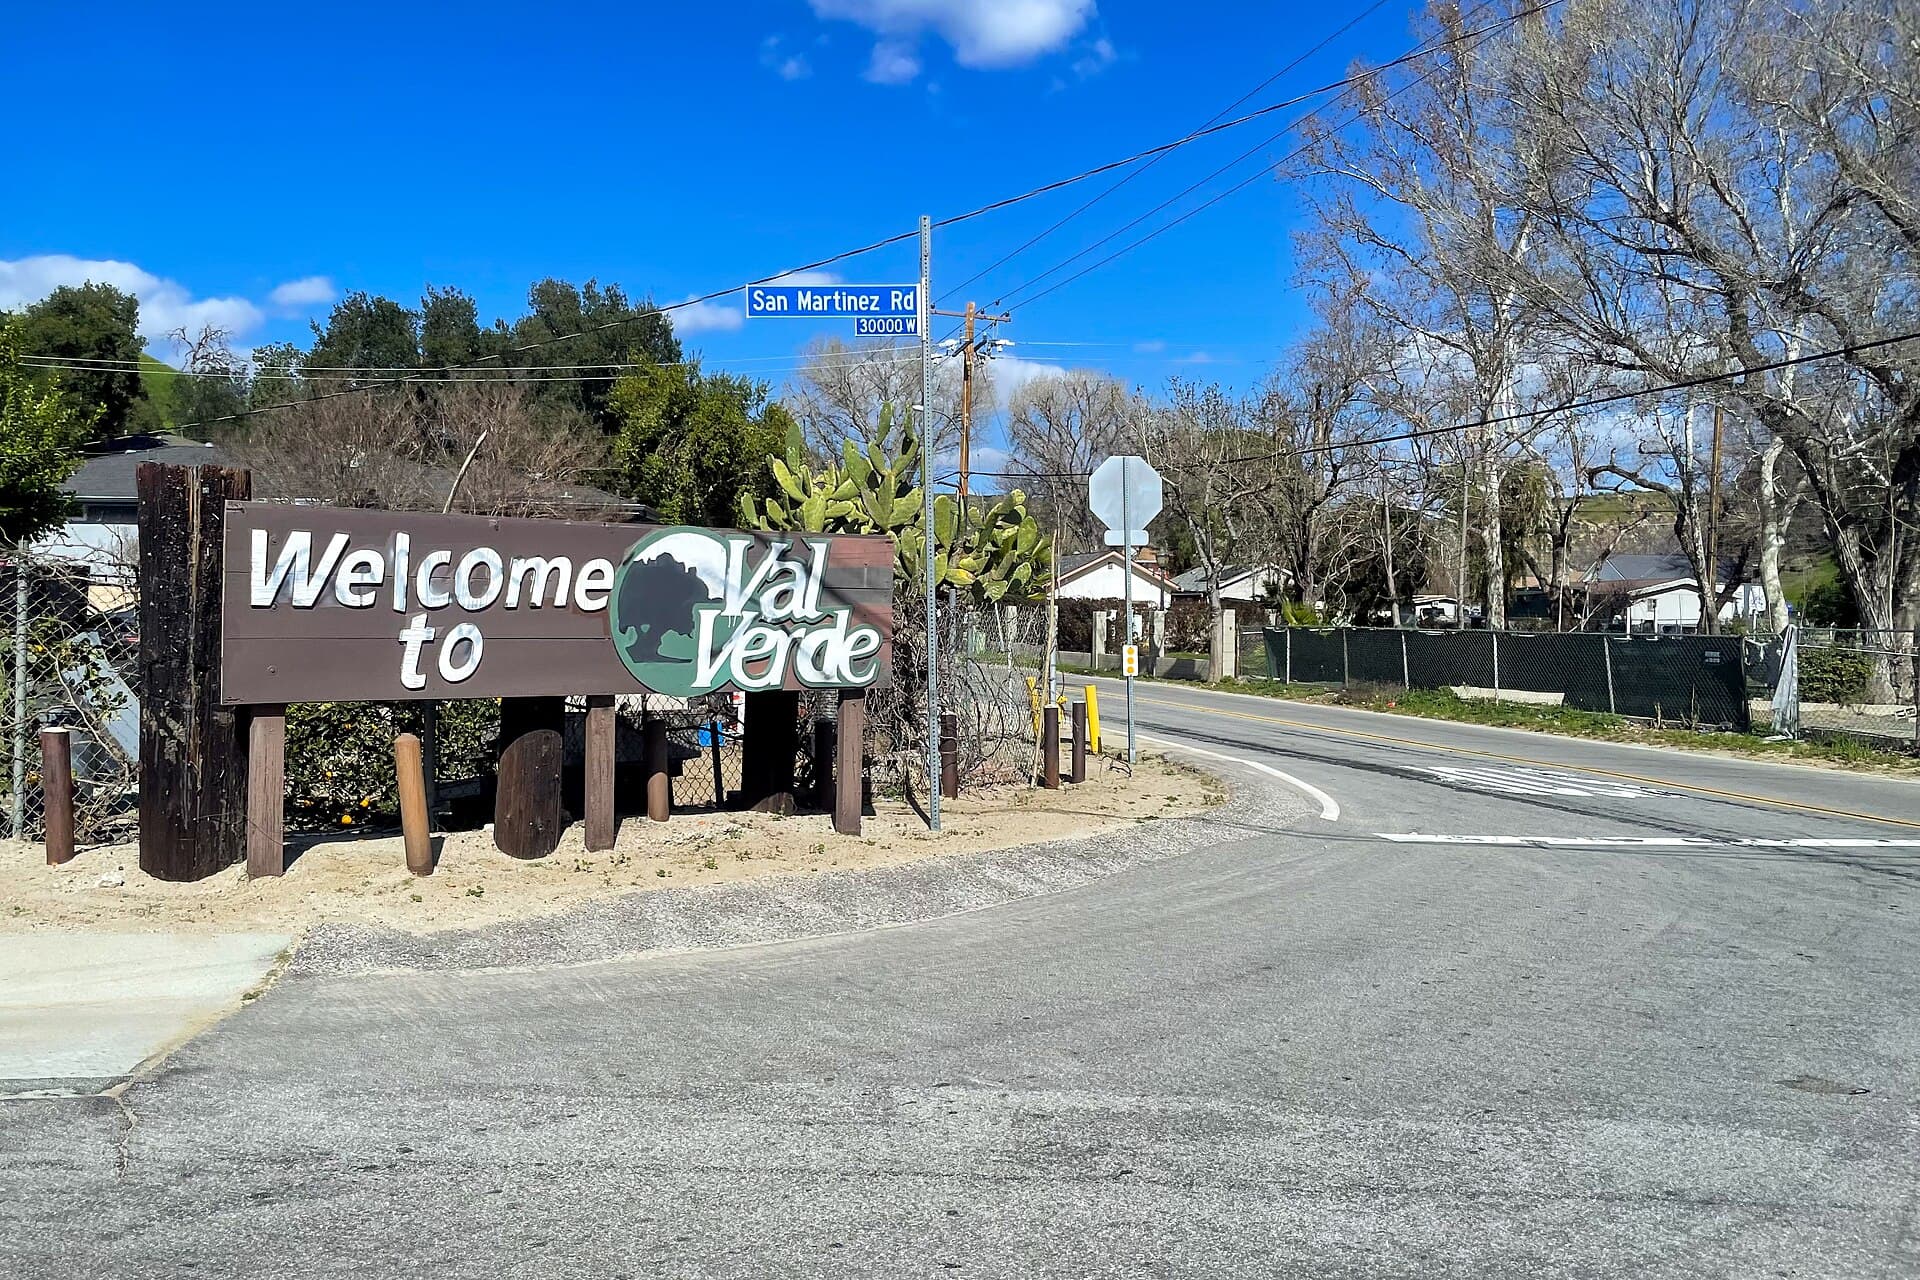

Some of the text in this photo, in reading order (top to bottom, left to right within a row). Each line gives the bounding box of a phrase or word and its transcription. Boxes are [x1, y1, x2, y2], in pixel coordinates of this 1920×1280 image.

[753, 290, 914, 311] San Martinez Rd
[860, 319, 916, 333] 30000 W
[249, 528, 616, 612] Welcome
[722, 538, 830, 622] Val
[399, 612, 485, 690] to
[690, 609, 881, 689] Verde
